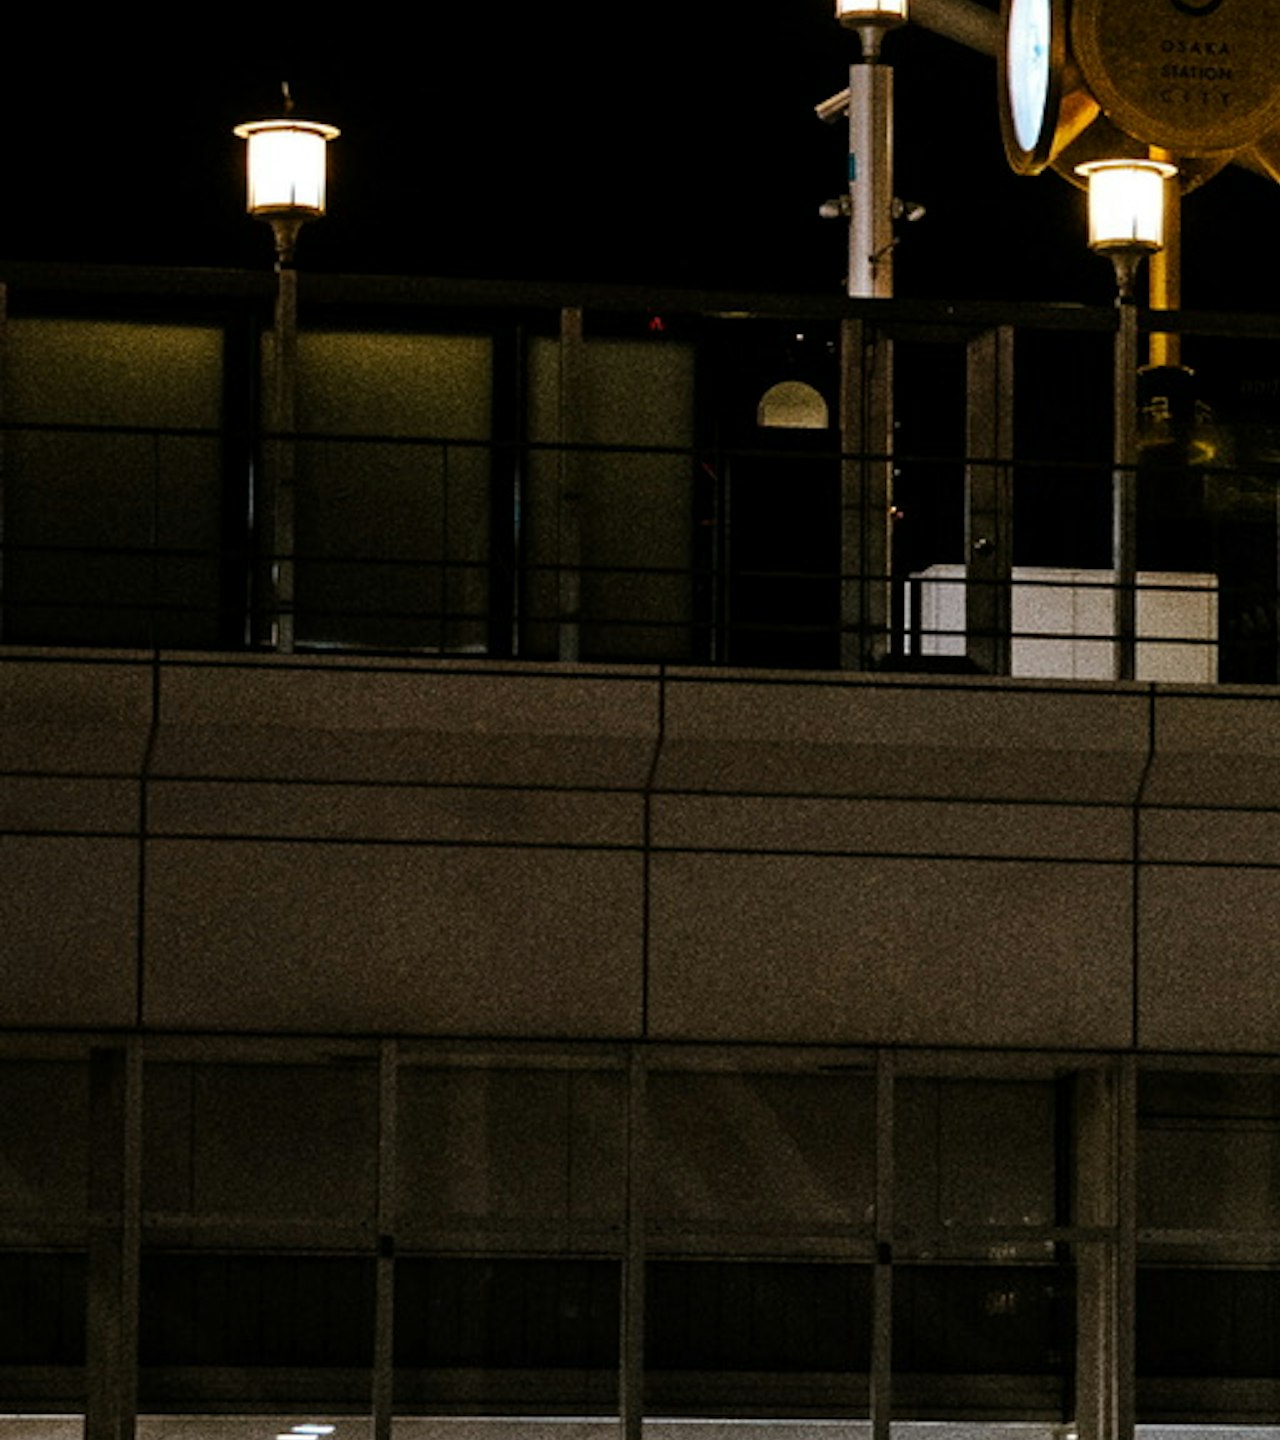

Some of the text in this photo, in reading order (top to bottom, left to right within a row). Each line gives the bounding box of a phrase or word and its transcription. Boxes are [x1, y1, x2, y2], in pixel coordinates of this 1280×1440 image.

[1161, 39, 1230, 54] OSAKA
[1161, 65, 1232, 80] STATION
[1161, 88, 1232, 105] CITY
